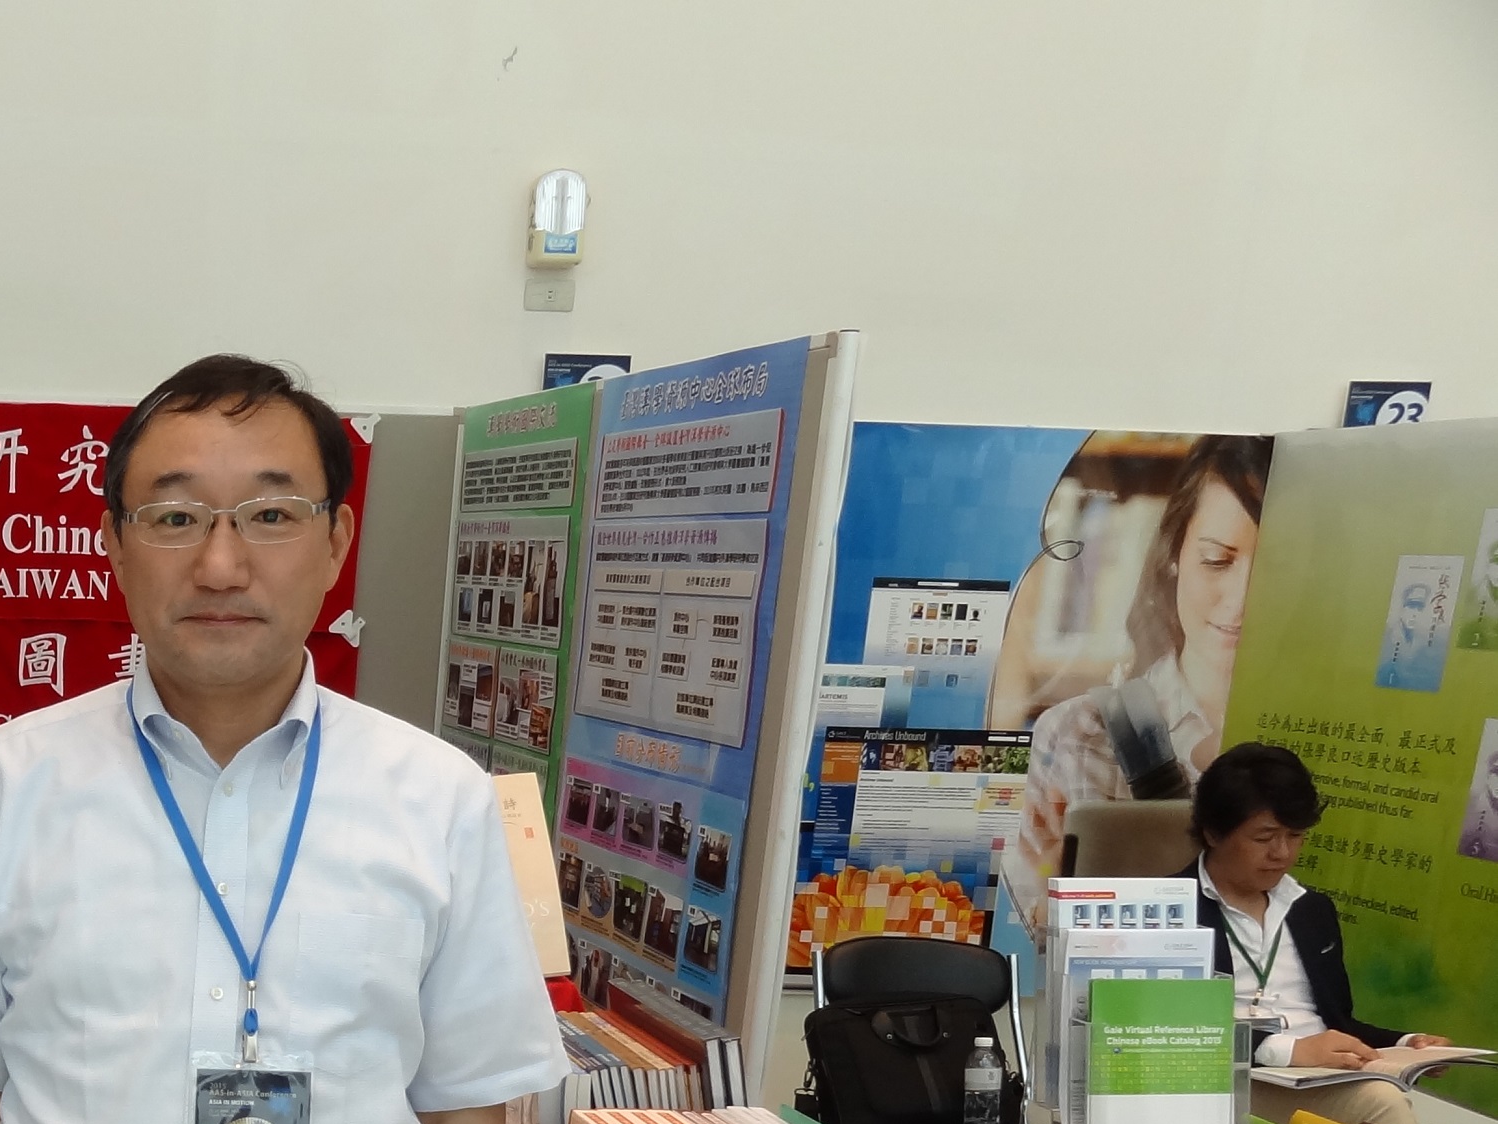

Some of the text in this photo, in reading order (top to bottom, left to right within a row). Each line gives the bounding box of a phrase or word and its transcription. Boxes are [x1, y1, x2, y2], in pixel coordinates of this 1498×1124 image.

[1388, 402, 1424, 425] 23
[2, 513, 107, 556] Chine
[864, 729, 926, 742] Archives Unbound
[1196, 1026, 1225, 1037] Library
